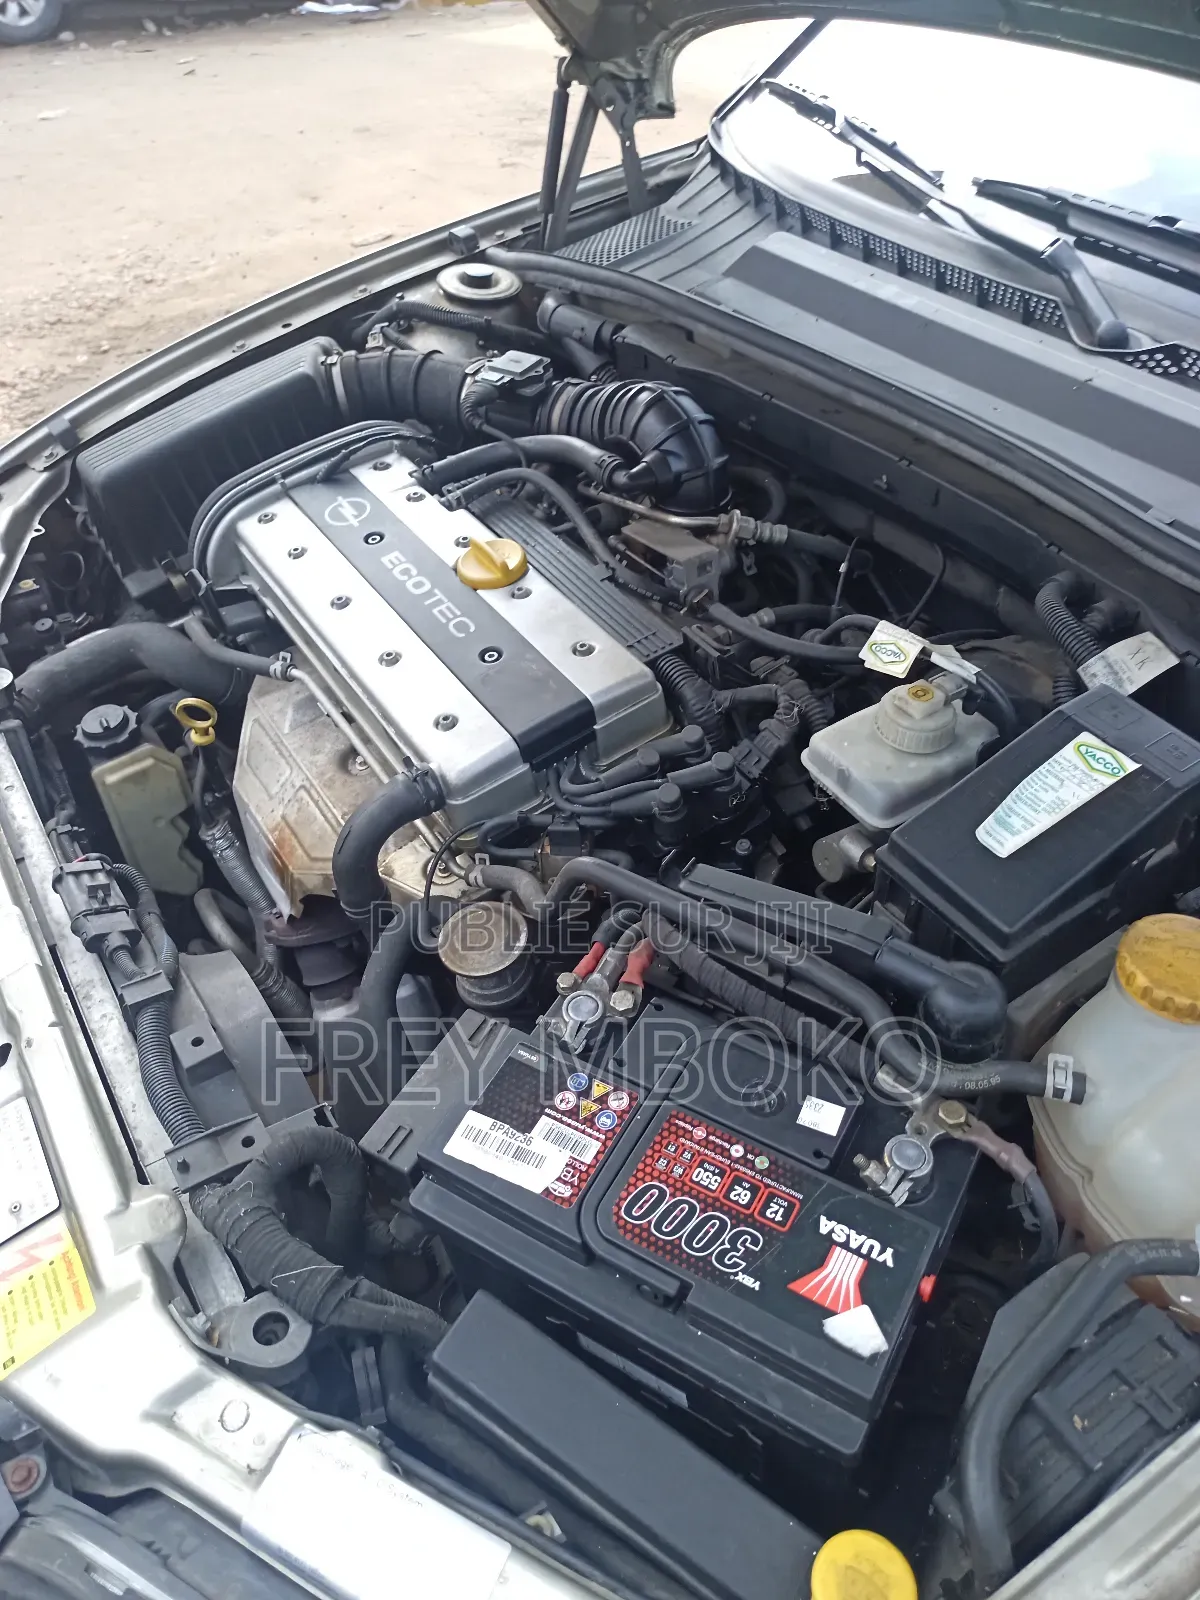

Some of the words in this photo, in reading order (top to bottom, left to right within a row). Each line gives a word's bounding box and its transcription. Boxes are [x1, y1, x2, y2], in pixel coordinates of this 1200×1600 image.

[380, 551, 475, 638] ECOTEC
[874, 645, 902, 660] YACCO
[1083, 747, 1122, 776] YACCO
[691, 1167, 721, 1191] 550
[729, 1185, 751, 1205] 62
[773, 1197, 788, 1208] VOLT
[765, 1203, 785, 1222] 12
[622, 1182, 763, 1273] 3000
[819, 1214, 894, 1268] YUASA
